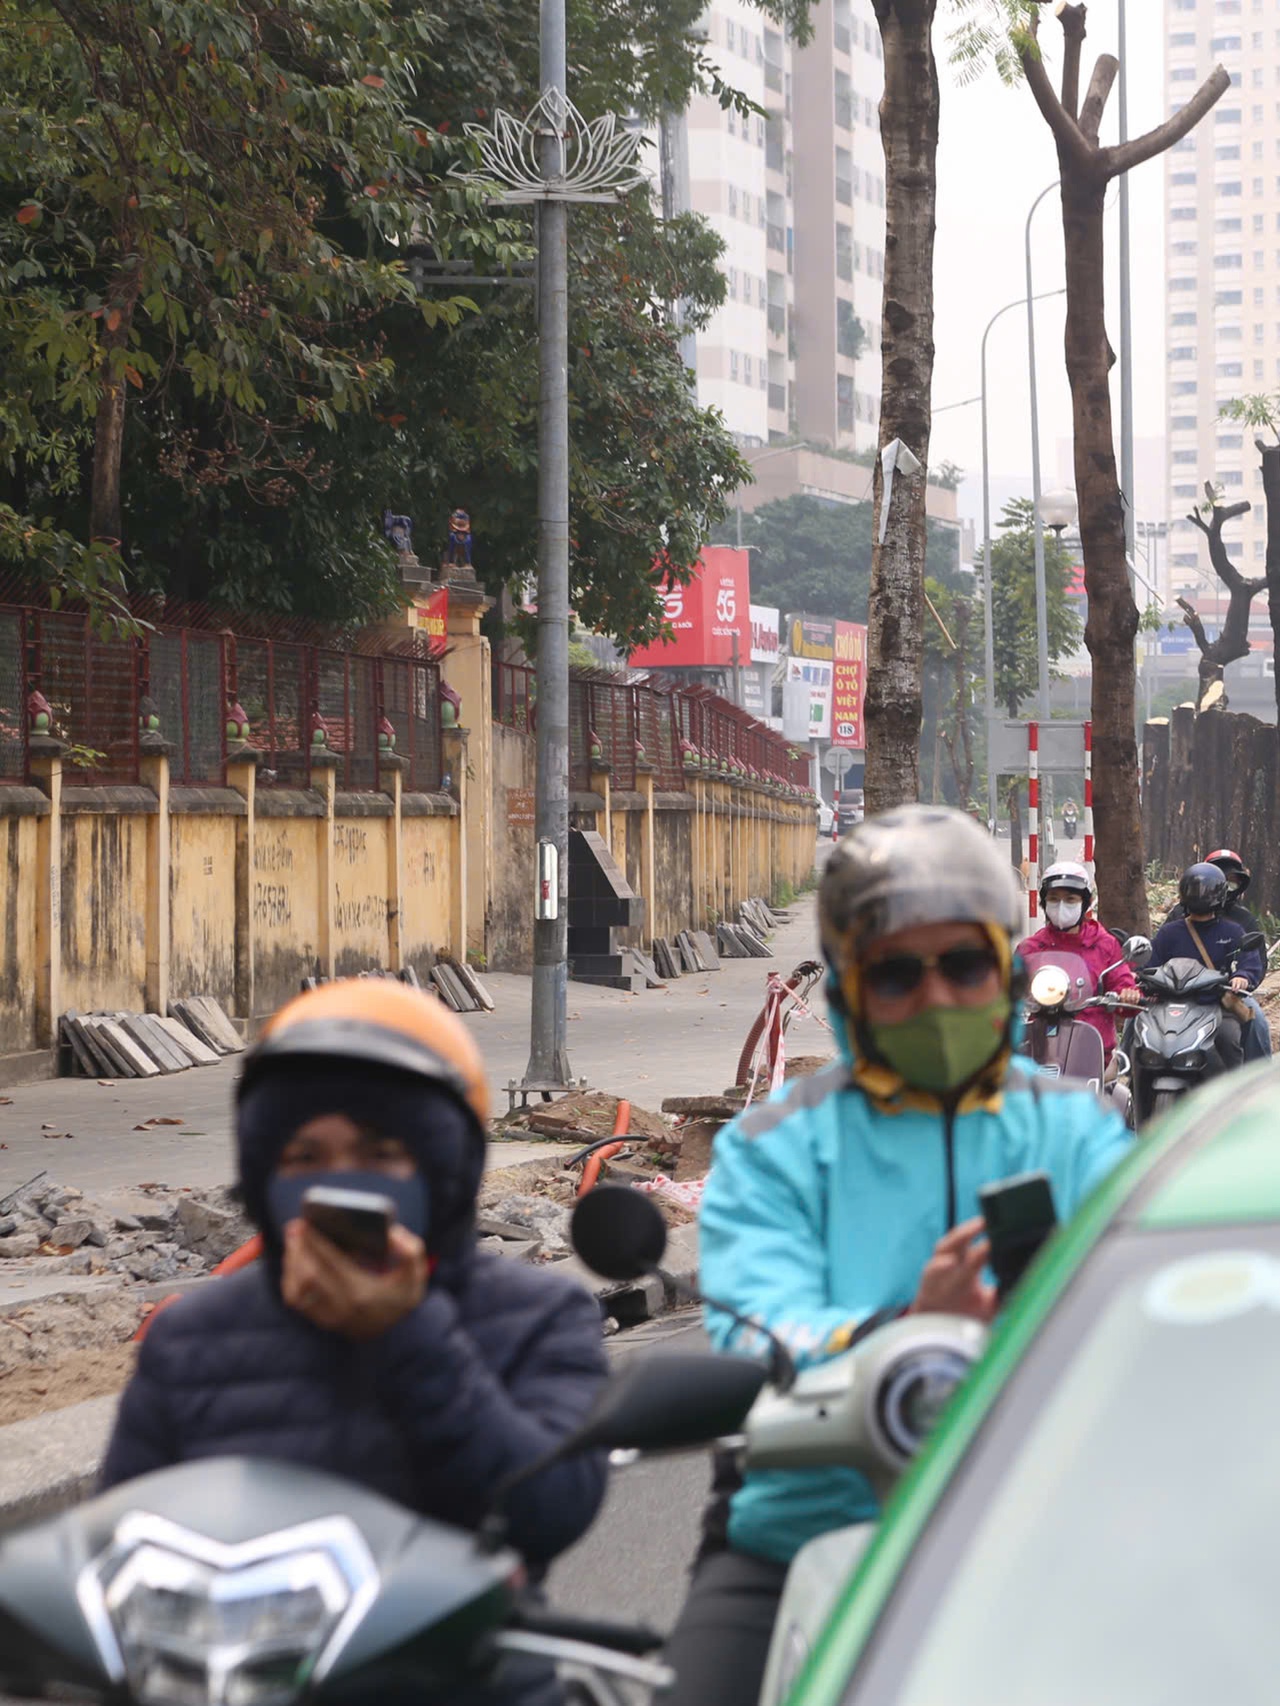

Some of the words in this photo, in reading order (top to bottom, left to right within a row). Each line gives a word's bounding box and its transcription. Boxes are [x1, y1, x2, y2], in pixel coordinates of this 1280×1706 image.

[716, 589, 736, 622] 5G
[836, 664, 857, 678] CHỢ
[836, 678, 844, 690] Ô
[846, 679, 858, 691] TÔ
[836, 694, 857, 708] VIỆT
[835, 711, 858, 721] NAM
[839, 725, 853, 735] 118
